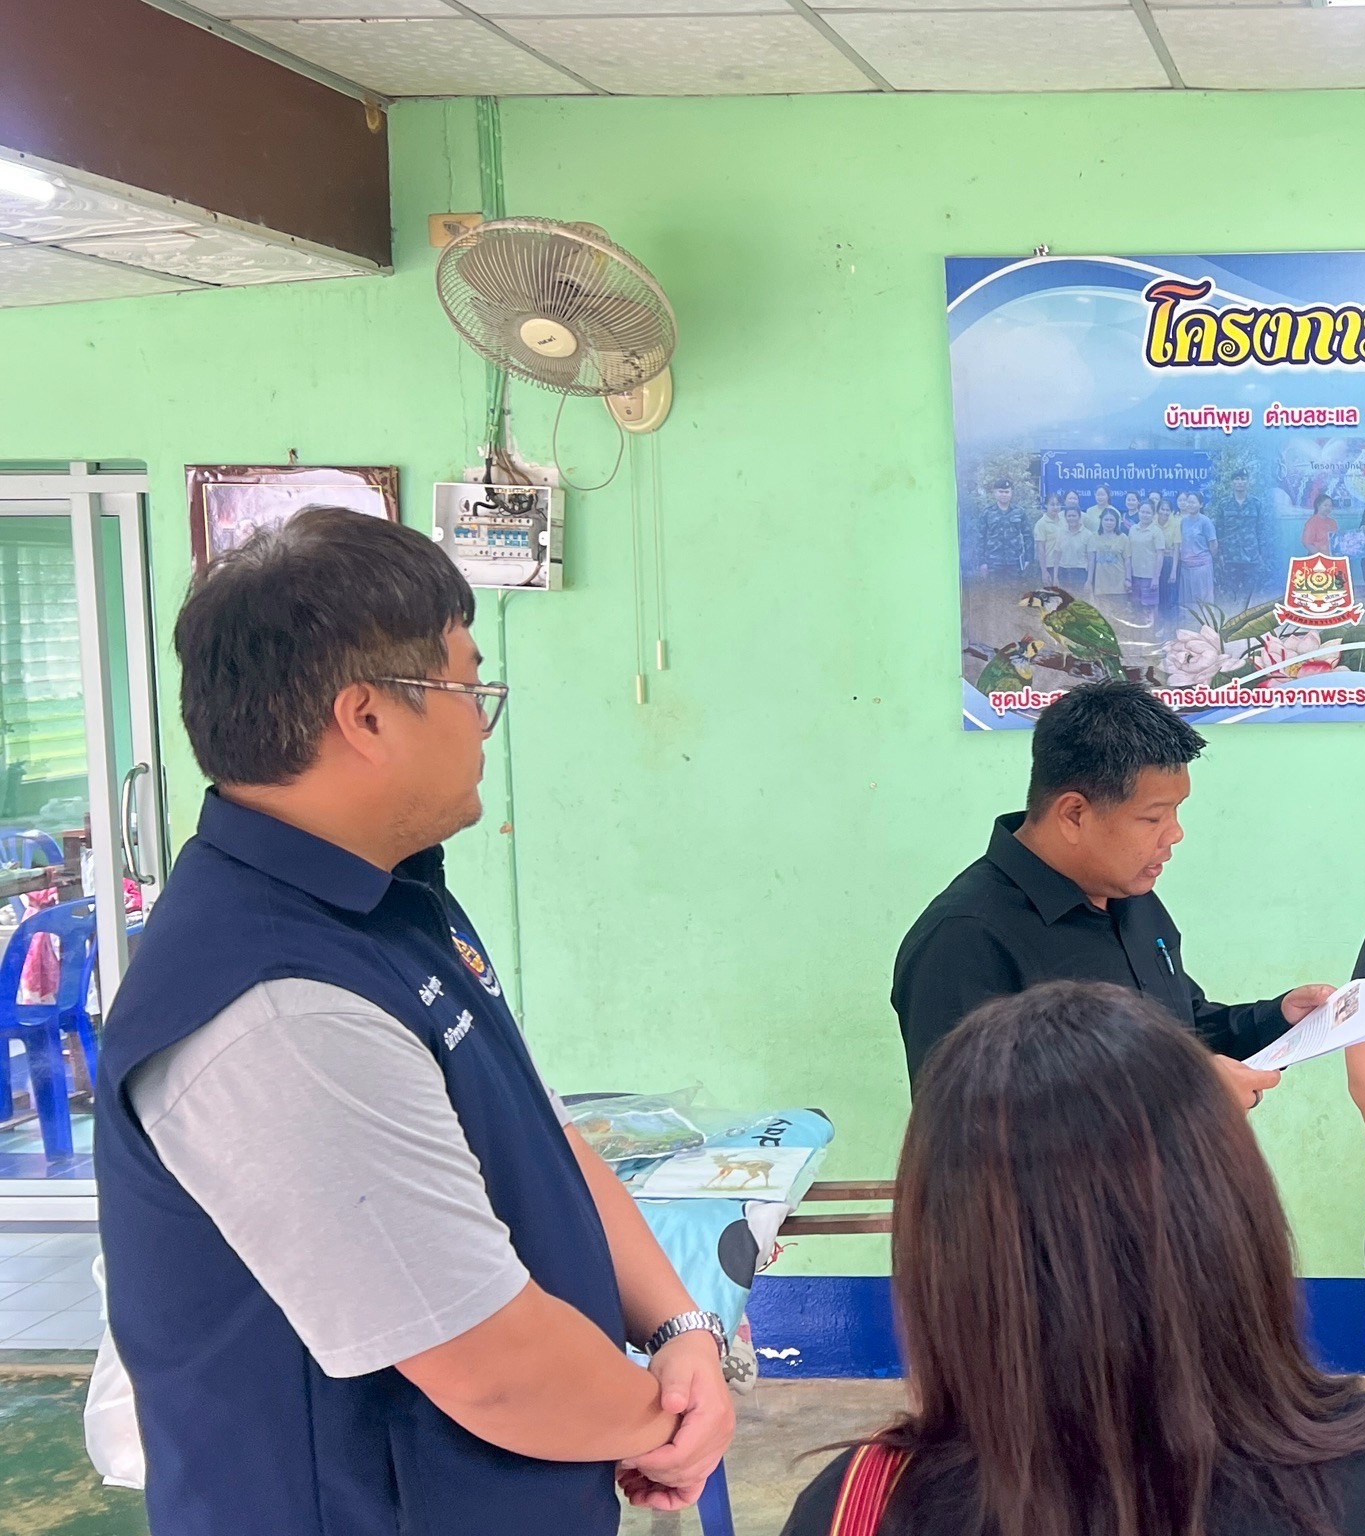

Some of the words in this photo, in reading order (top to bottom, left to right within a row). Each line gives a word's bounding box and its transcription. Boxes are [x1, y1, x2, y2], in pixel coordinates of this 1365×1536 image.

[1166, 406, 1250, 431] บ้านทิพุเย
[1265, 404, 1358, 424] ตำบลชะแล
[1055, 461, 1208, 484] โรงฝึกศิลปาชีพบ้านทิพุเย
